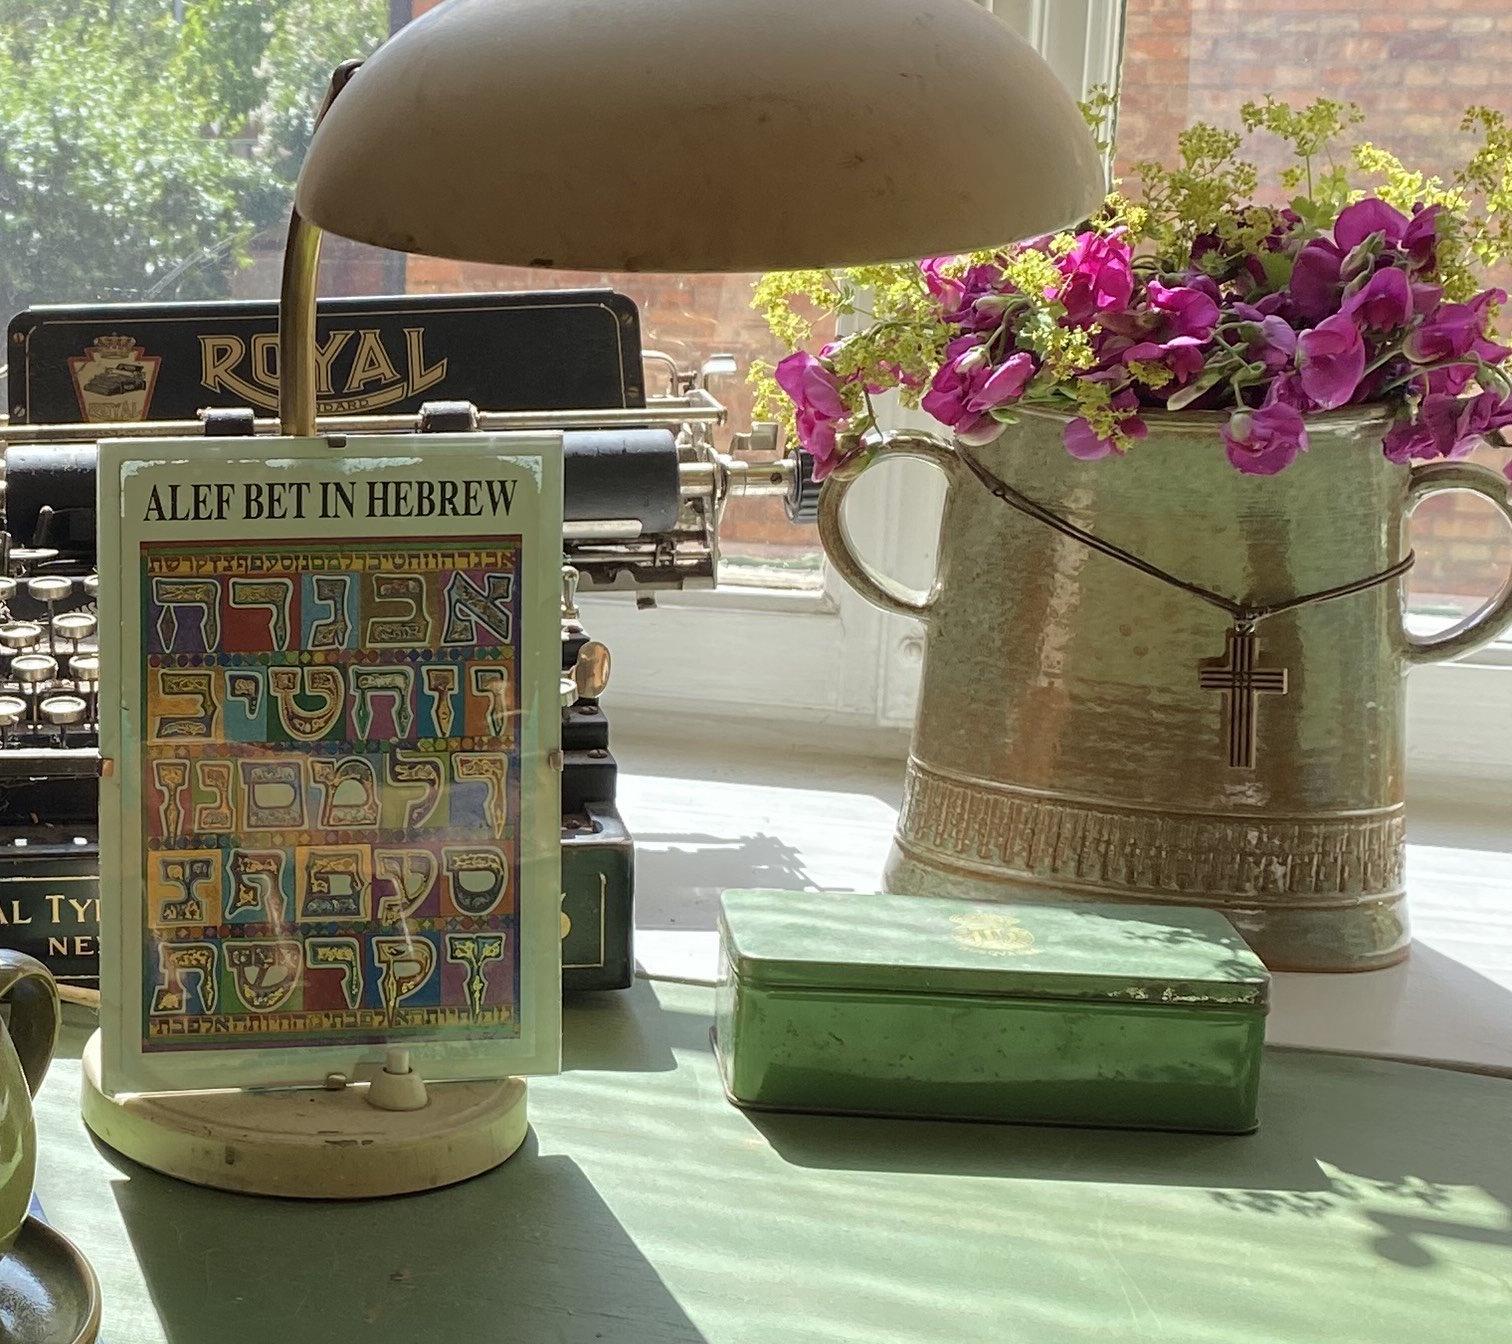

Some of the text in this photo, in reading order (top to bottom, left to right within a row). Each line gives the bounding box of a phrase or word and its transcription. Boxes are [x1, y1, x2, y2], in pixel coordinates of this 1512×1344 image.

[197, 327, 448, 400] ROYAL
[143, 479, 518, 522] ALEF BET IN HEBREW
[45, 895, 101, 924] TY
[48, 936, 101, 956] NE
